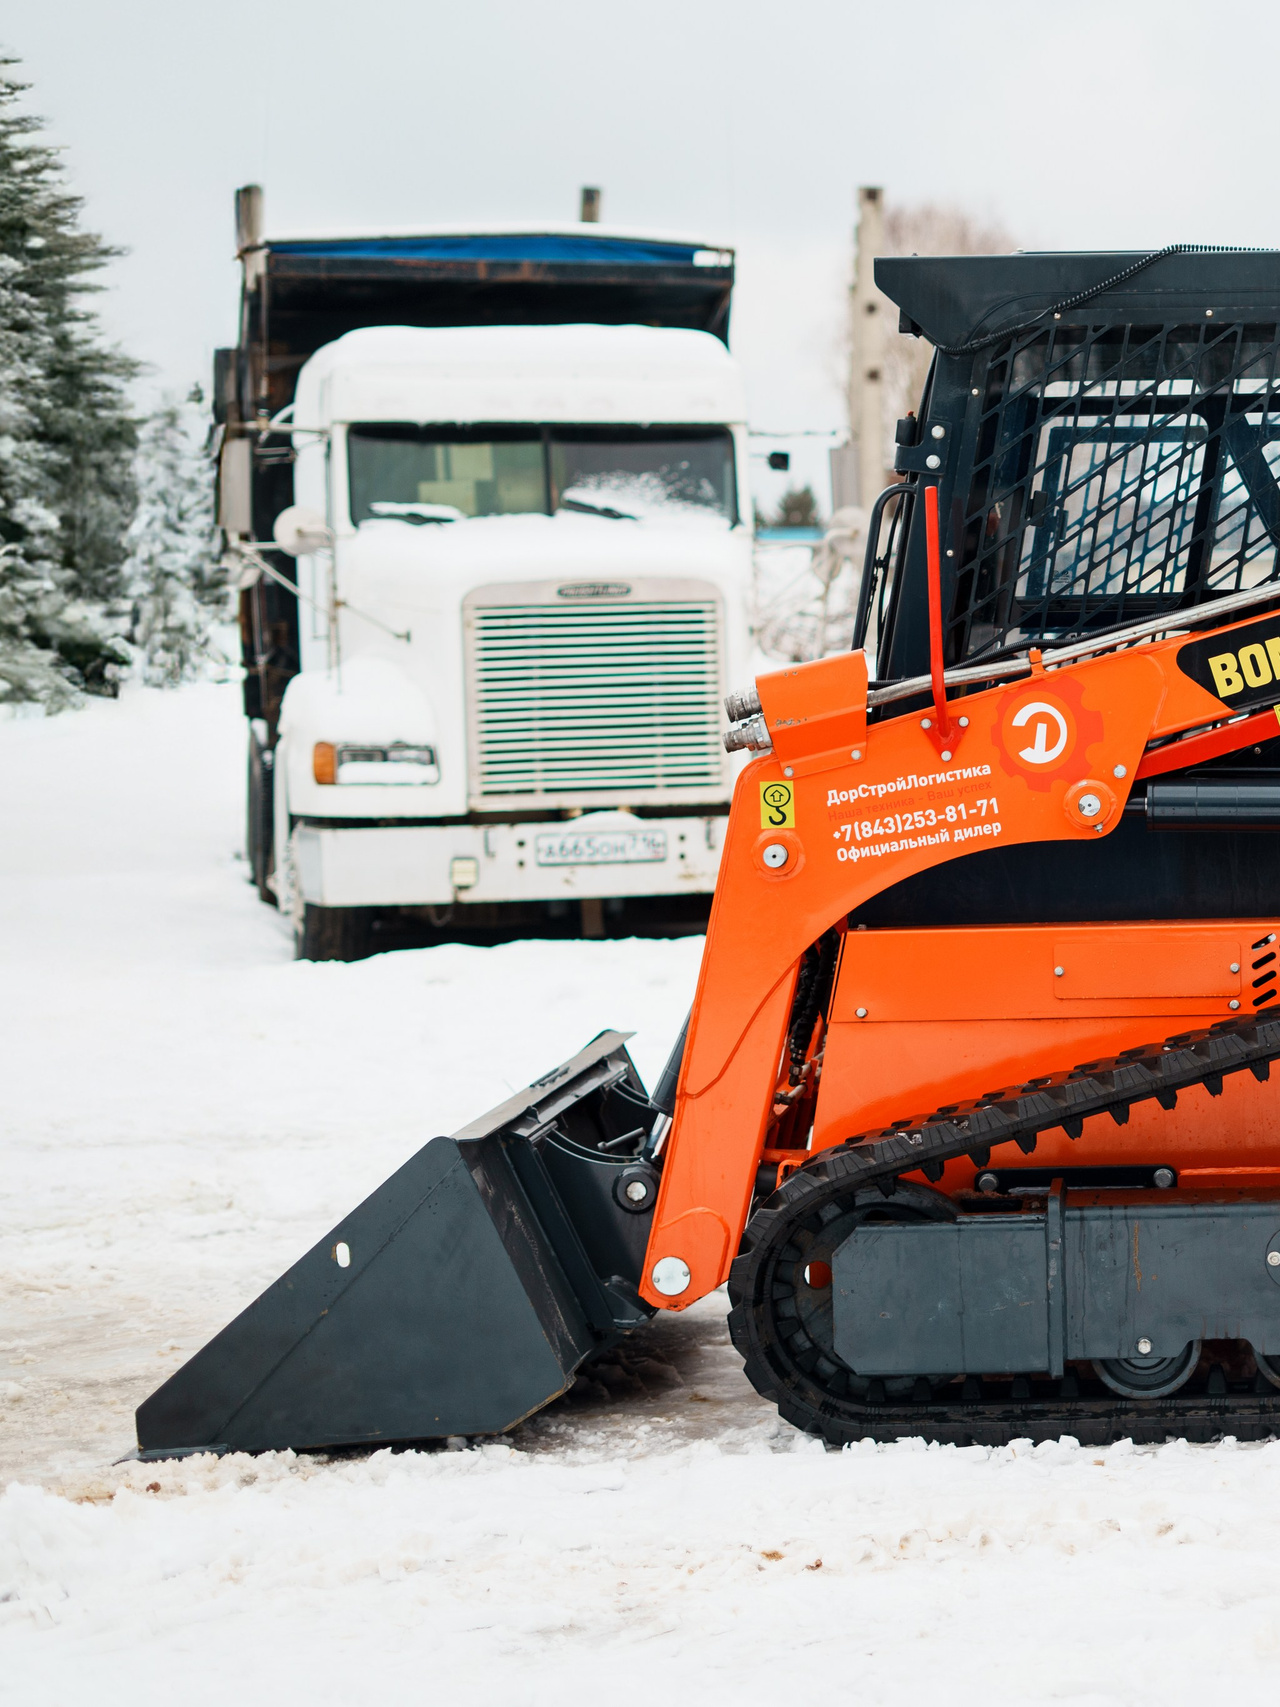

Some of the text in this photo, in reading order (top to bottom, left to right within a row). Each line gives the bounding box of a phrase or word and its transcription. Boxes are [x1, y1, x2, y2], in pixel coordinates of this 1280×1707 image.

[826, 764, 992, 807] ДорСтройЛогистика
[827, 808, 863, 822] Наша
[866, 796, 915, 814] техника
[927, 788, 955, 802] Ваш
[958, 780, 992, 798] успех
[832, 797, 999, 842] +7(843)253-81-71
[836, 821, 1002, 863] Официальный дилер
